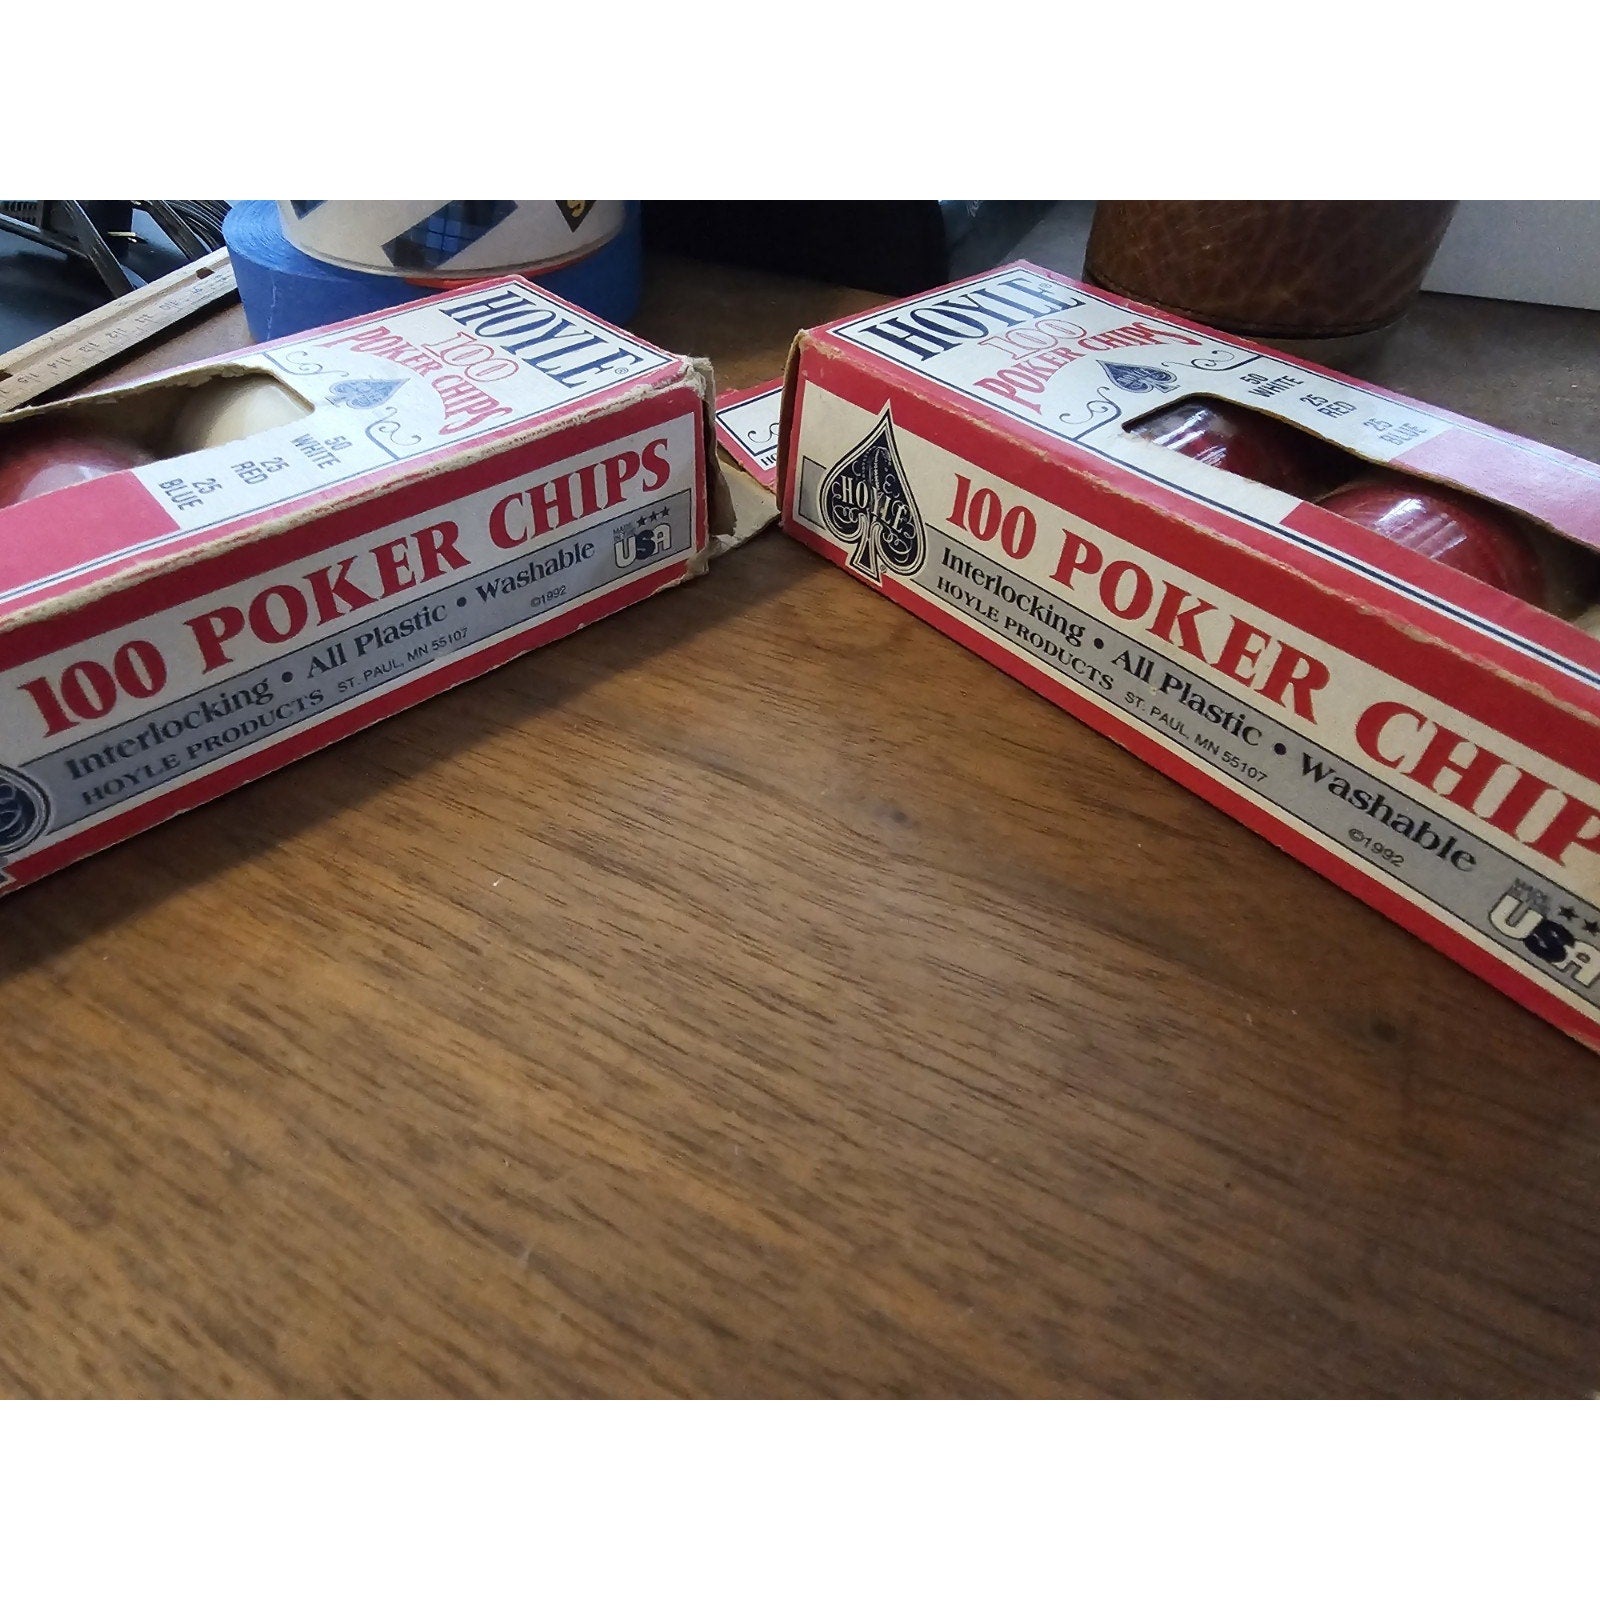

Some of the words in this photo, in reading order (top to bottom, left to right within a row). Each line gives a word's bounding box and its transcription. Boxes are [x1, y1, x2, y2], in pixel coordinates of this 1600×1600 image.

[858, 276, 1086, 362] HOYLE
[977, 319, 1087, 360] 100
[421, 331, 519, 382] 100
[973, 347, 1086, 415] POKER
[1077, 321, 1203, 351] CHIPS
[319, 326, 444, 377] POKER
[431, 374, 513, 436] CHIPS
[1240, 373, 1269, 385] 50
[1247, 375, 1304, 399] WHITE
[1300, 393, 1329, 408] 25
[1317, 401, 1357, 419] RED
[1363, 417, 1393, 432] 25
[291, 433, 342, 469] WHITE
[323, 436, 353, 451] 50
[1378, 422, 1428, 446] BLUE
[191, 477, 224, 495] 25
[231, 461, 268, 486] RED
[260, 457, 290, 474] 25
[158, 480, 204, 511] BLUE
[840, 474, 907, 534] HOYLE
[614, 522, 672, 568] USA
[16, 640, 167, 738] 100
[183, 520, 471, 674] POKER
[488, 438, 671, 549] CHIPS
[946, 472, 1037, 560] 100
[1049, 528, 1331, 725] POKER
[66, 676, 274, 781] Interlocking
[307, 642, 348, 678] All
[354, 600, 448, 657] Plastic
[474, 540, 595, 603] Washable
[936, 576, 999, 624] HOYLE
[1003, 615, 1114, 691] PRODUCTS
[1150, 704, 1190, 740] PAUL,
[1194, 733, 1220, 756] MN
[1222, 749, 1268, 784] 55107
[81, 753, 182, 805] HOYLE
[187, 690, 324, 760] PRODUCTS
[363, 660, 405, 685] PAUL,
[406, 644, 429, 662] MN
[431, 627, 468, 651] 55107
[940, 547, 1086, 649] Interlocking
[1111, 649, 1152, 686] All
[1159, 671, 1263, 748] Plastic
[1300, 751, 1477, 872] Washable
[1488, 888, 1600, 989] USA
